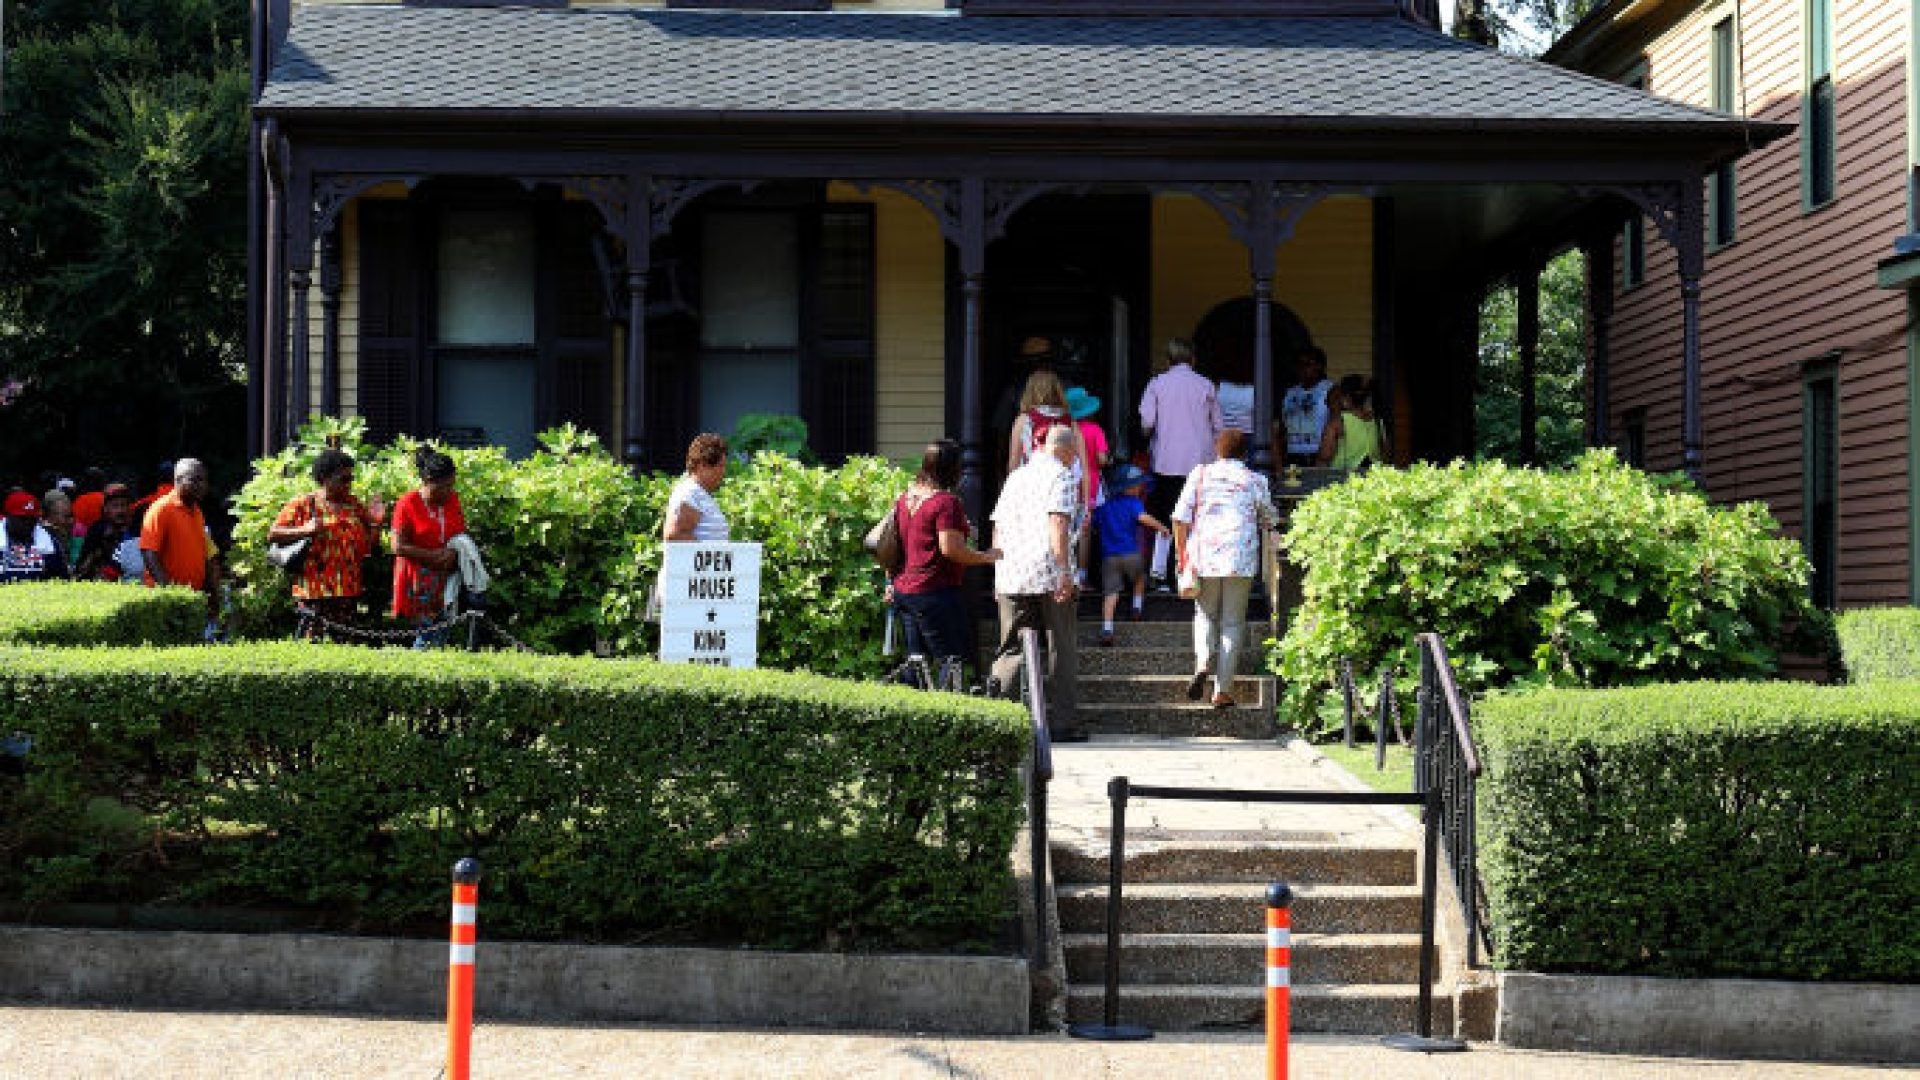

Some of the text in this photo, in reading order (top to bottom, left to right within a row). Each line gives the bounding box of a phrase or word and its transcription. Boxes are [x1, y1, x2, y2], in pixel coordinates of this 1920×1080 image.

[693, 550, 733, 572] OPEN
[688, 577, 735, 599] HOUSE
[693, 630, 726, 651] KING
